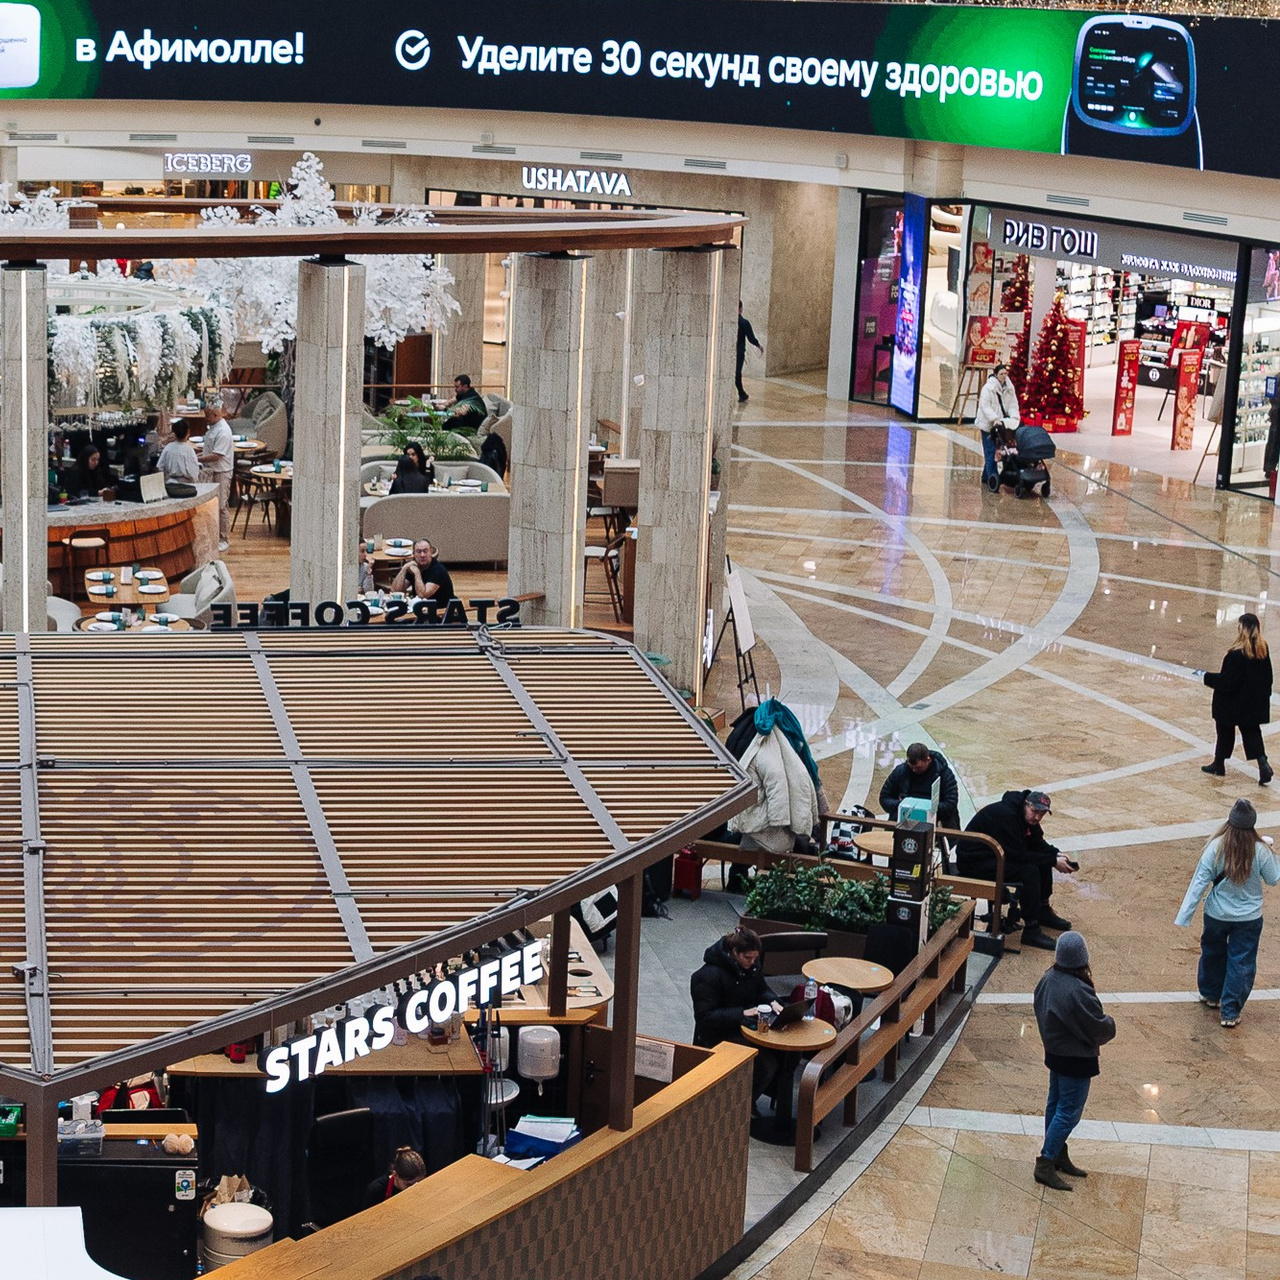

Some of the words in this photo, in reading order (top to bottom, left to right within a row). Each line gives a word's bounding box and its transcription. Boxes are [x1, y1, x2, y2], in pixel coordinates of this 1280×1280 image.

[75, 38, 97, 63] в
[104, 28, 304, 70] Афимолле!
[457, 35, 592, 75] Уделите
[600, 39, 642, 76] 30
[648, 49, 762, 88] секунд
[767, 54, 879, 98] своему
[884, 59, 1045, 102] здоровью
[164, 152, 253, 174] ICEBERG
[521, 166, 633, 197] USHATAVA
[1002, 218, 1049, 252] РИВ
[1050, 224, 1100, 260] ГОШ
[1190, 296, 1212, 309] DIOR
[265, 1004, 395, 1094] STARS
[405, 940, 544, 1034] COFFEE
